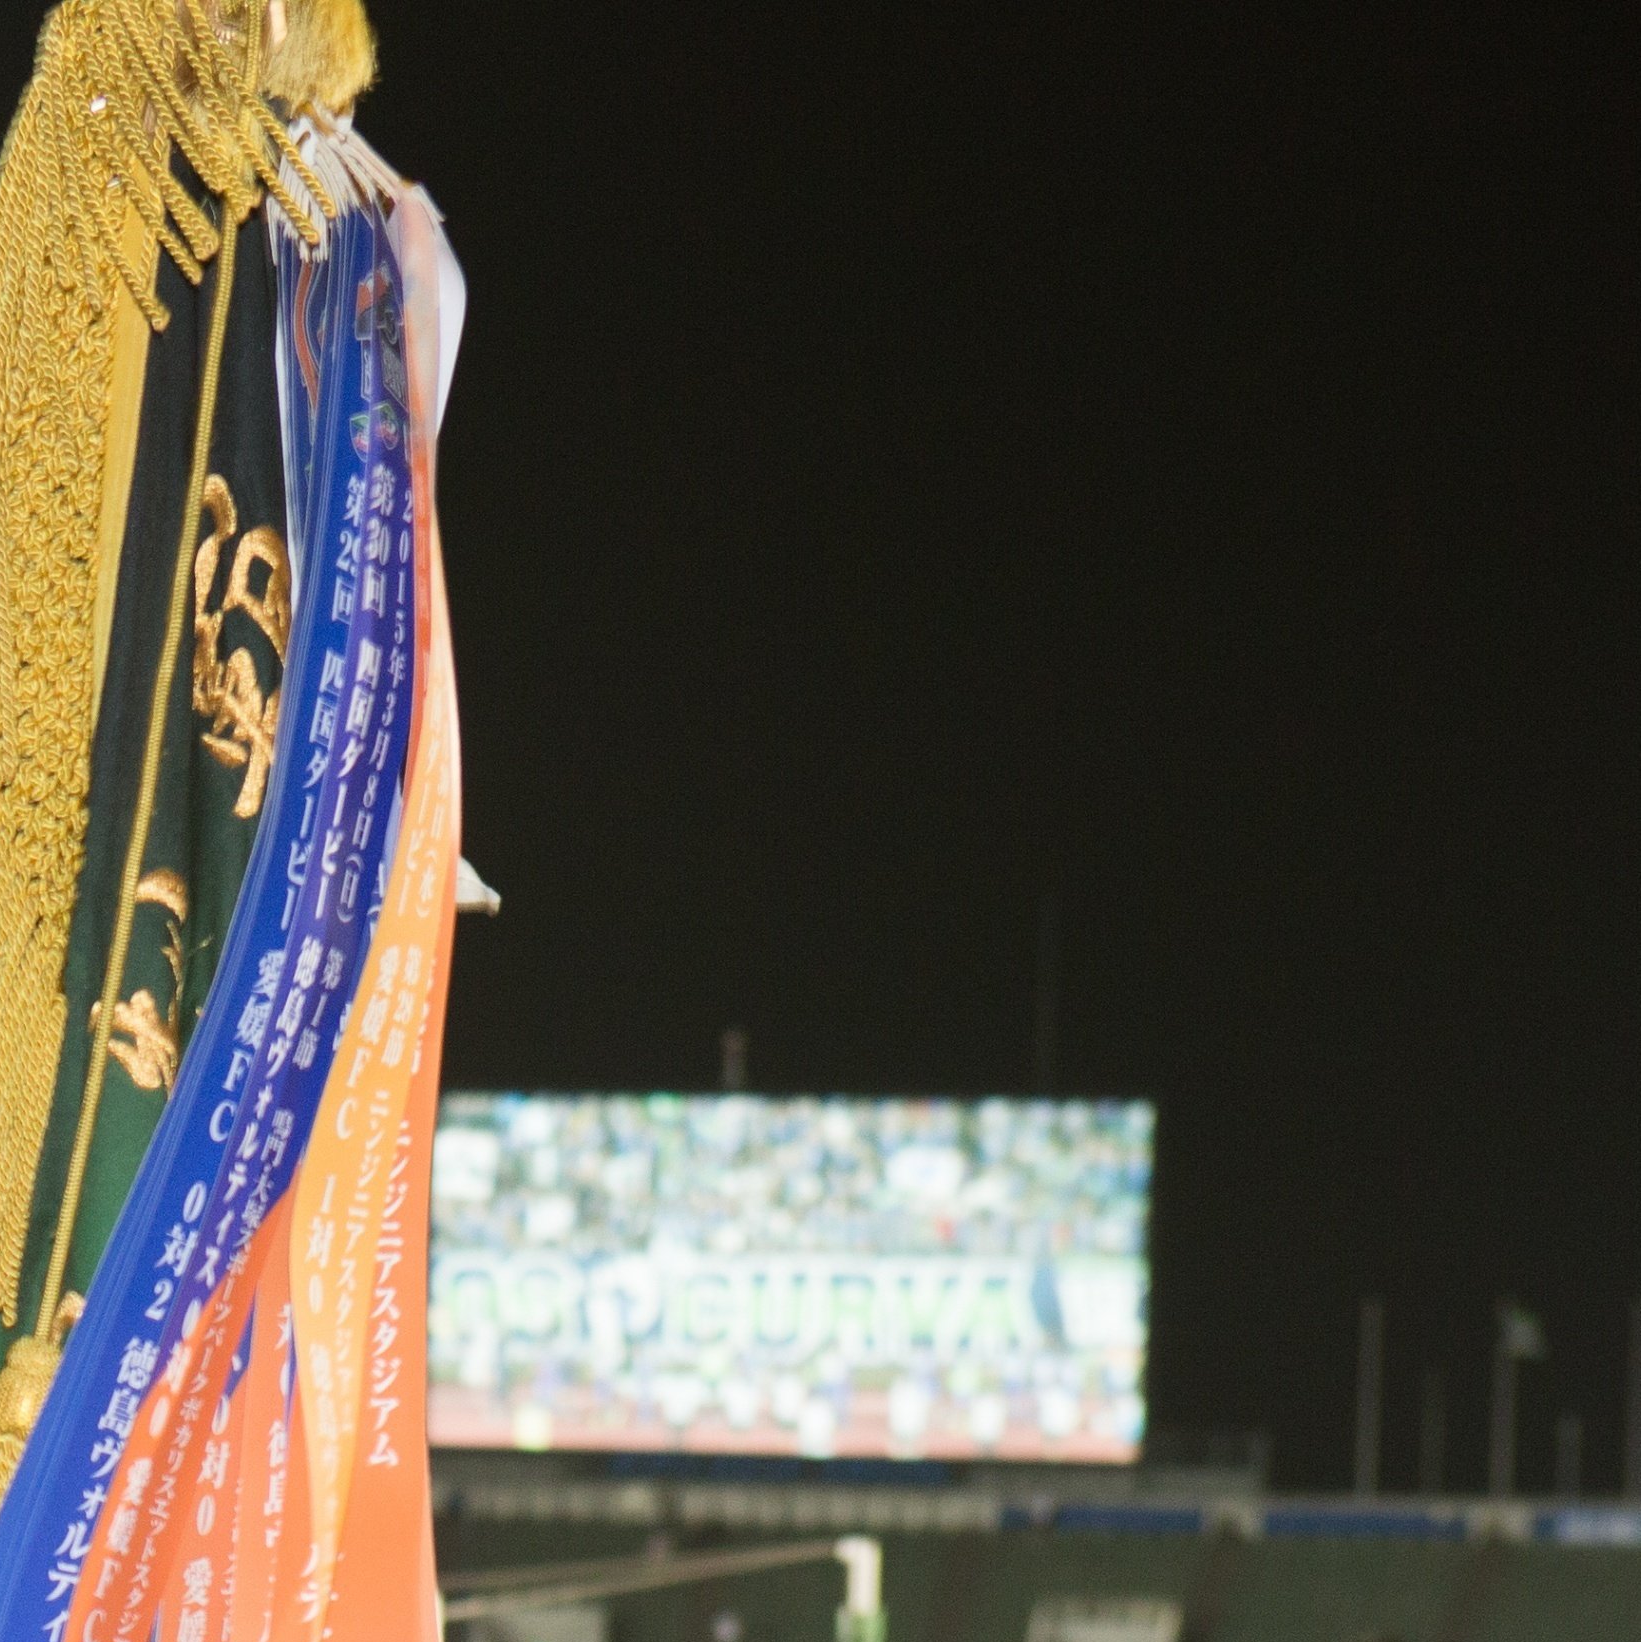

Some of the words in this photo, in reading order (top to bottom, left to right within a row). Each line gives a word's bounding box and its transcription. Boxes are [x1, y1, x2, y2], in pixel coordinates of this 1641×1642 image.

[315, 636, 383, 919] 四国ダービー
[194, 934, 324, 1288] 徳島ヴォルティス
